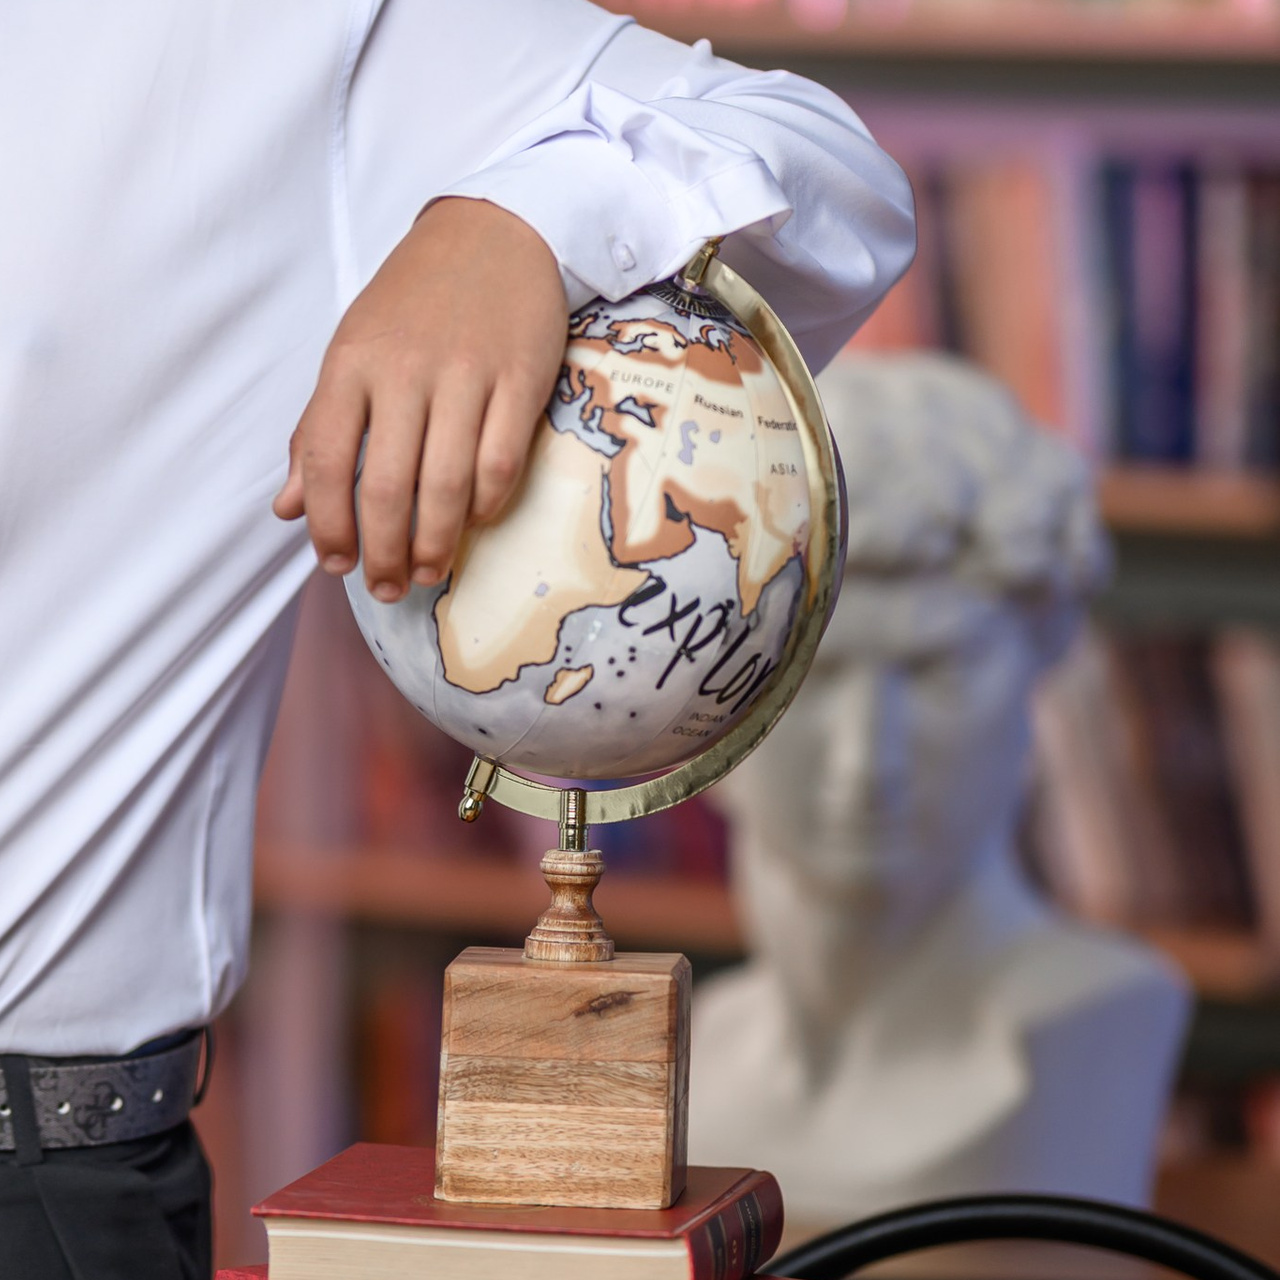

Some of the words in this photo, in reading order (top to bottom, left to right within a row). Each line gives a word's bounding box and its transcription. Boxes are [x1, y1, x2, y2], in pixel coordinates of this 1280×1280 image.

[610, 369, 675, 395] EUROPE
[694, 394, 744, 419] Russian
[770, 464, 798, 476] ASIA
[689, 712, 727, 724] INDIAN
[672, 725, 713, 738] OCEAN
